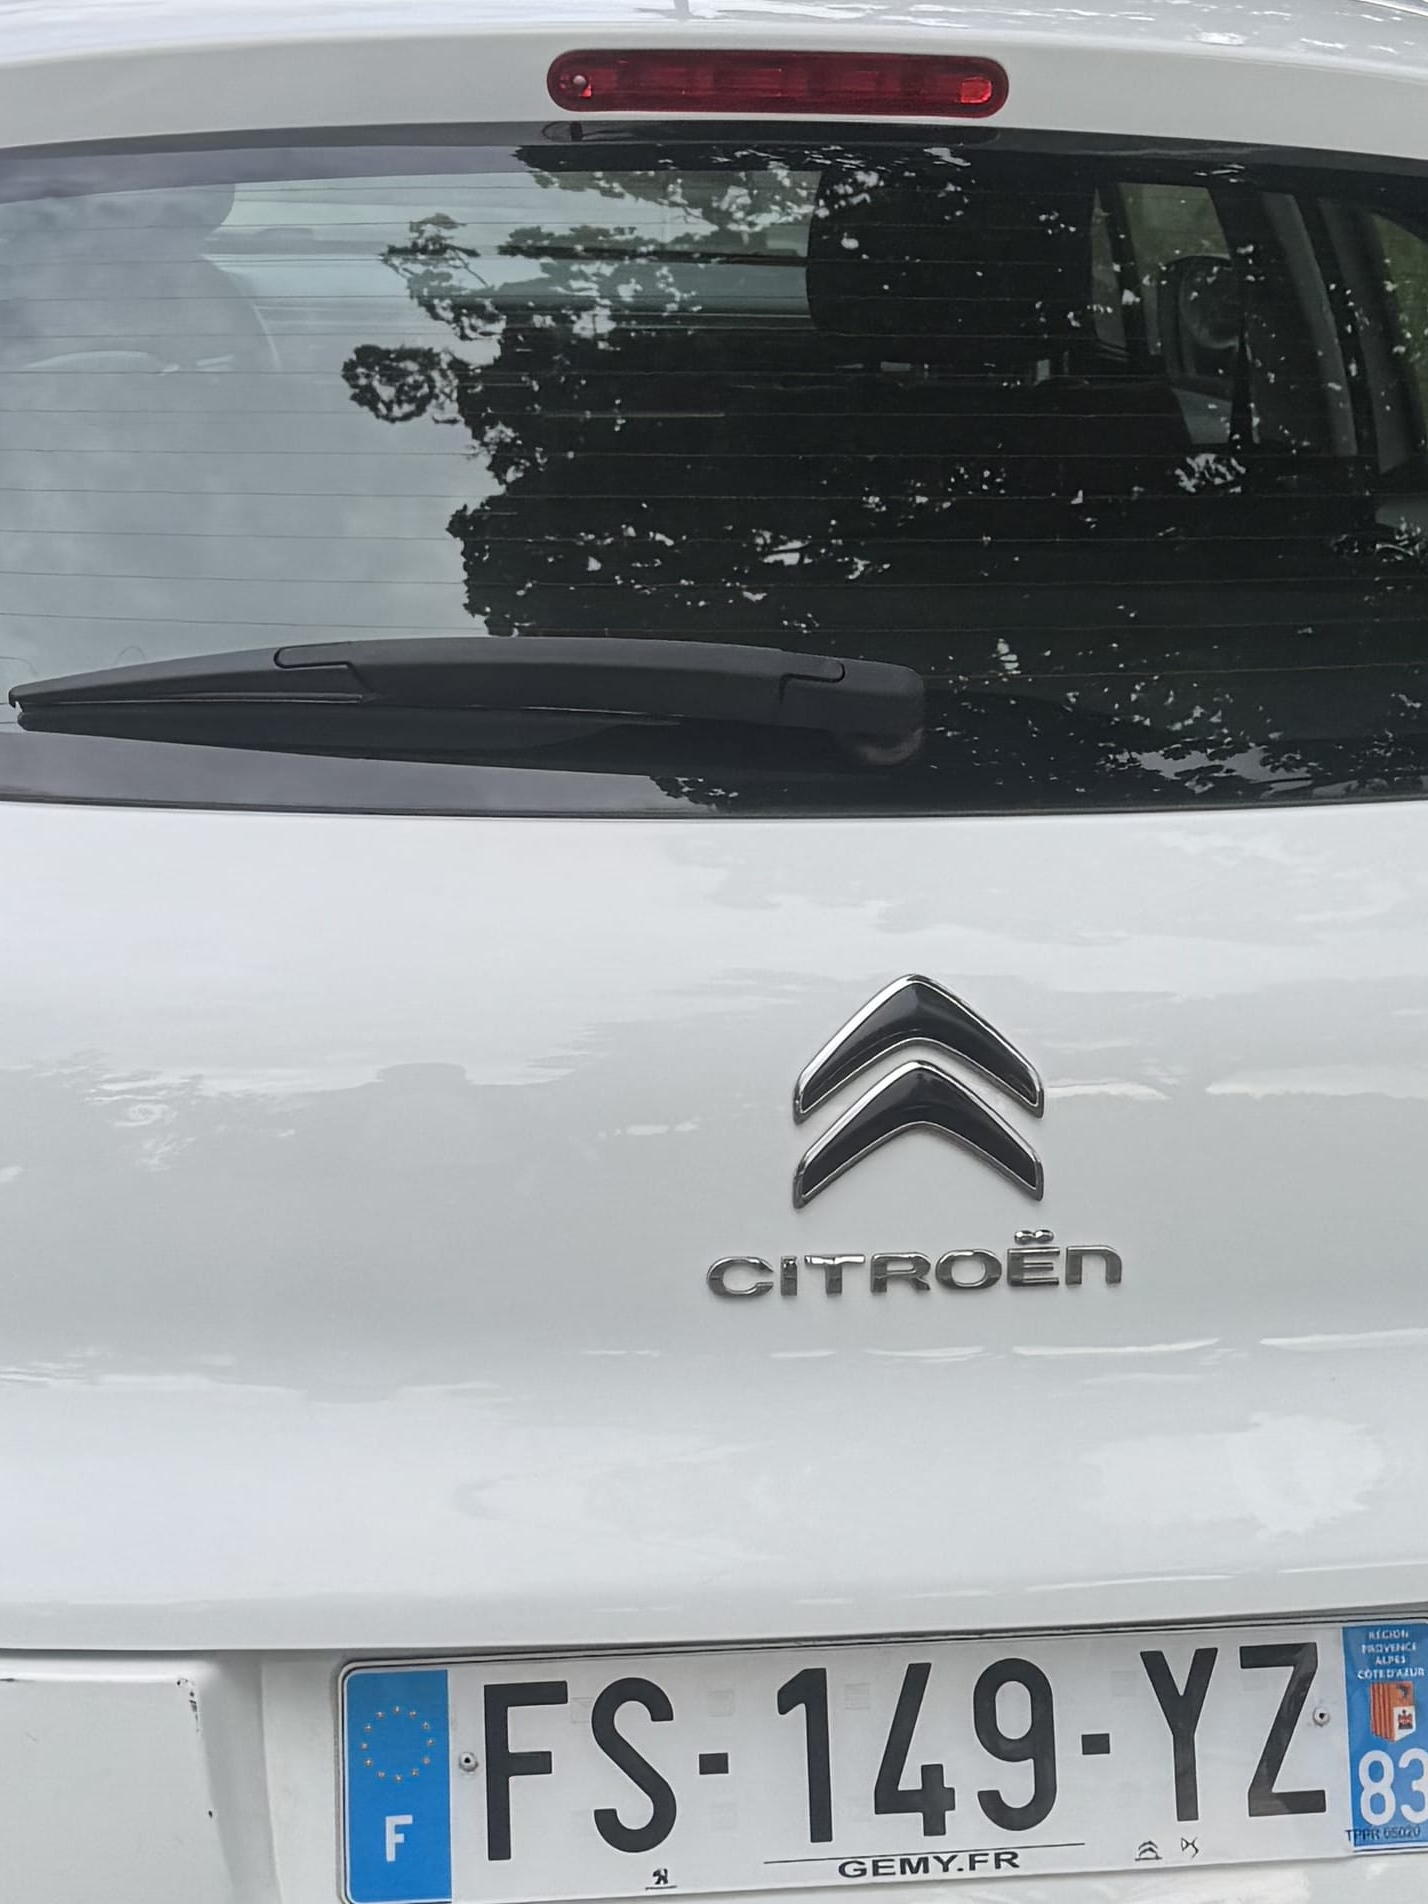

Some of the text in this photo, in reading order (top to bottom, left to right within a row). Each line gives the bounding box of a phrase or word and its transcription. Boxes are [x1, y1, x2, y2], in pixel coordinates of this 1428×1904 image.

[1361, 1642, 1417, 1654] PROVENCE
[1375, 1655, 1406, 1666] ALPES
[481, 1642, 1327, 1862] FS-149-YZ
[385, 1814, 413, 1862] F
[838, 1851, 1021, 1878] GEMY.FR
